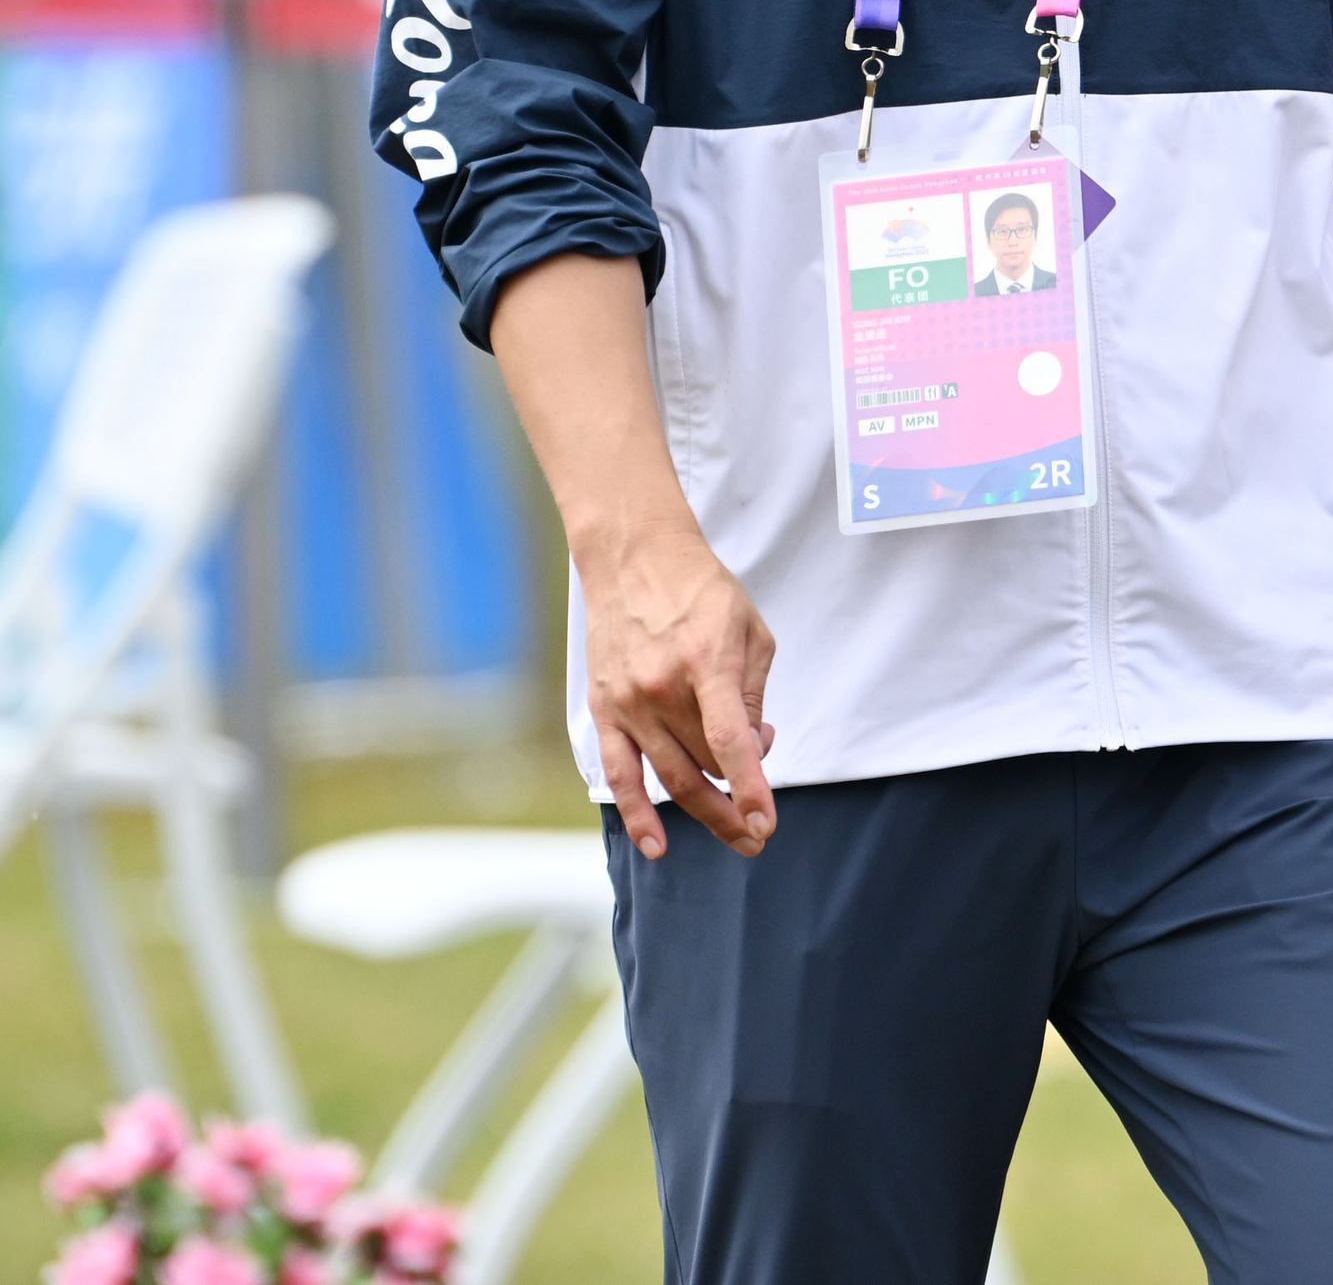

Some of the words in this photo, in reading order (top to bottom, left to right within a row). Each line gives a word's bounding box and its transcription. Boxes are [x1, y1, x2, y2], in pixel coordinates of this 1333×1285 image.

[888, 265, 930, 291] FO
[891, 290, 929, 305] 代表团
[868, 420, 885, 432] AV
[905, 414, 936, 428] MPN
[1029, 459, 1072, 490] 2R
[863, 484, 880, 509] S
